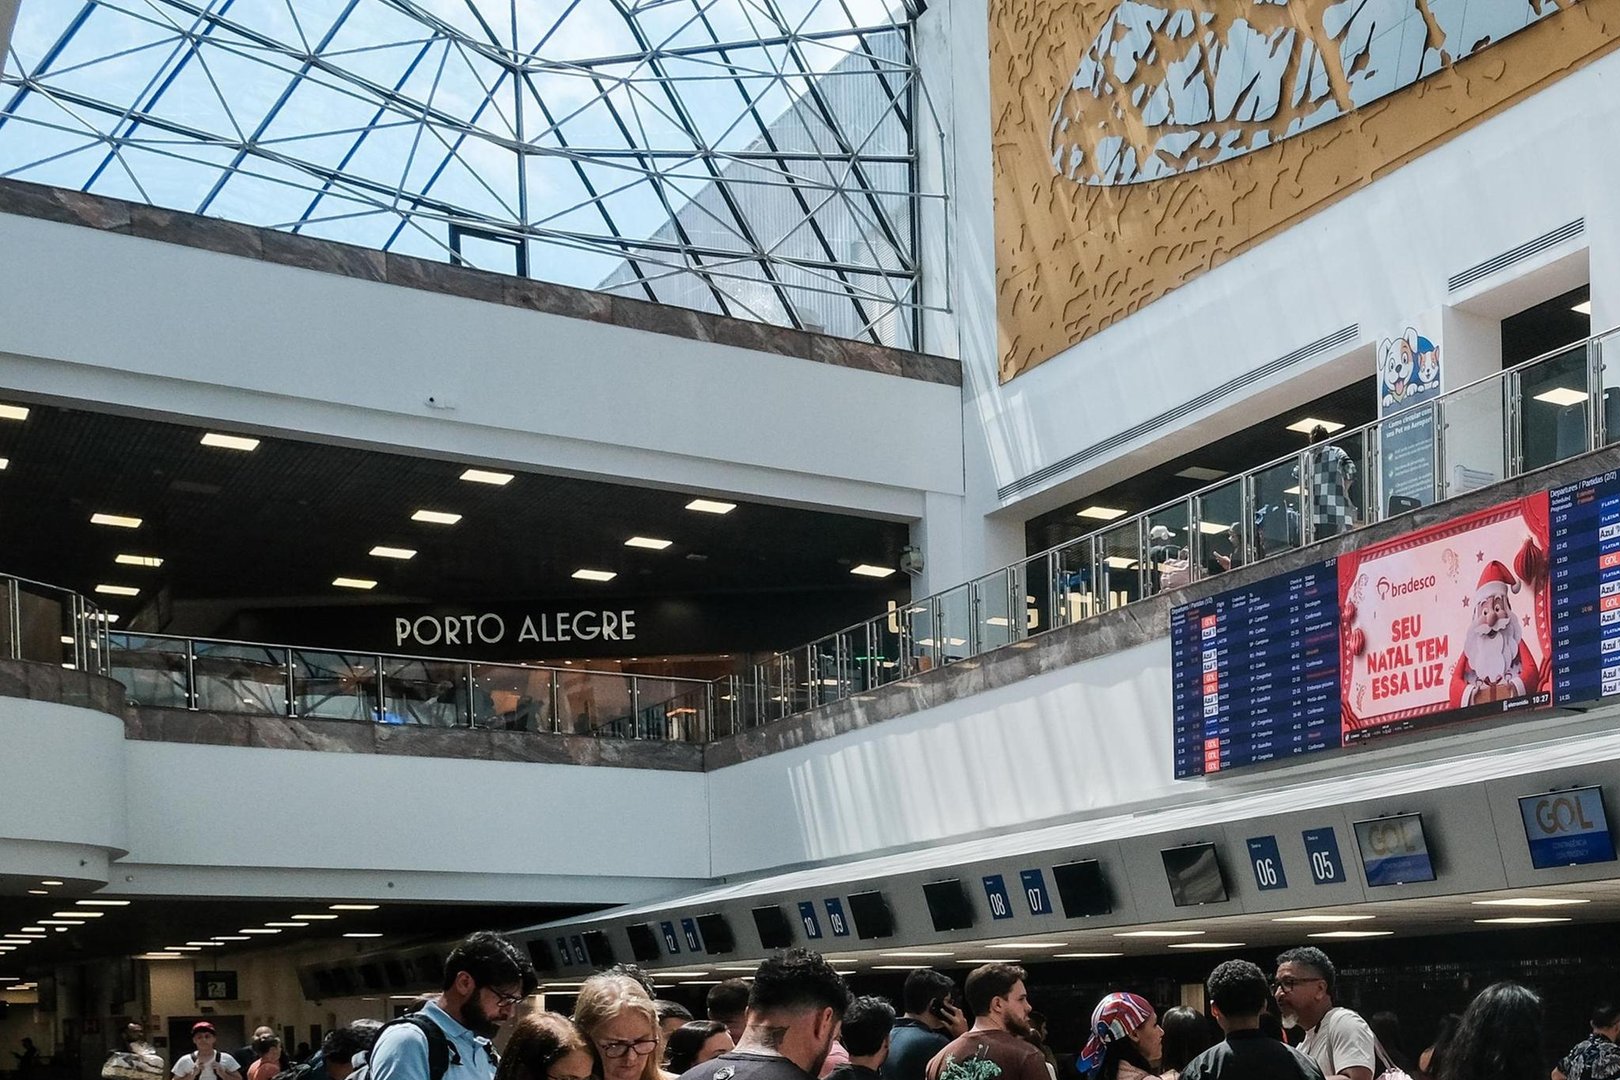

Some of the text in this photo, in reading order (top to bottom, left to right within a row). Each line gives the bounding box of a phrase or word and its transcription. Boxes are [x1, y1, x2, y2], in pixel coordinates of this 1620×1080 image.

[1550, 484, 1576, 498] Departures
[1581, 476, 1603, 488] Partidas
[1391, 576, 1436, 598] bradesco
[396, 610, 636, 646] PORTO ALEGRE
[1391, 614, 1421, 642] SEU
[1367, 635, 1448, 674] NATAL TEM
[1372, 663, 1444, 700] ESSA LUZ
[1532, 694, 1549, 704] 10:27
[1536, 796, 1594, 834] GOL
[1256, 858, 1277, 886] 06
[1312, 852, 1334, 880] 05
[990, 894, 1006, 916] 08
[1028, 888, 1044, 912] 07
[804, 917, 816, 936] 10
[831, 914, 842, 934] 09
[666, 934, 676, 950] 12
